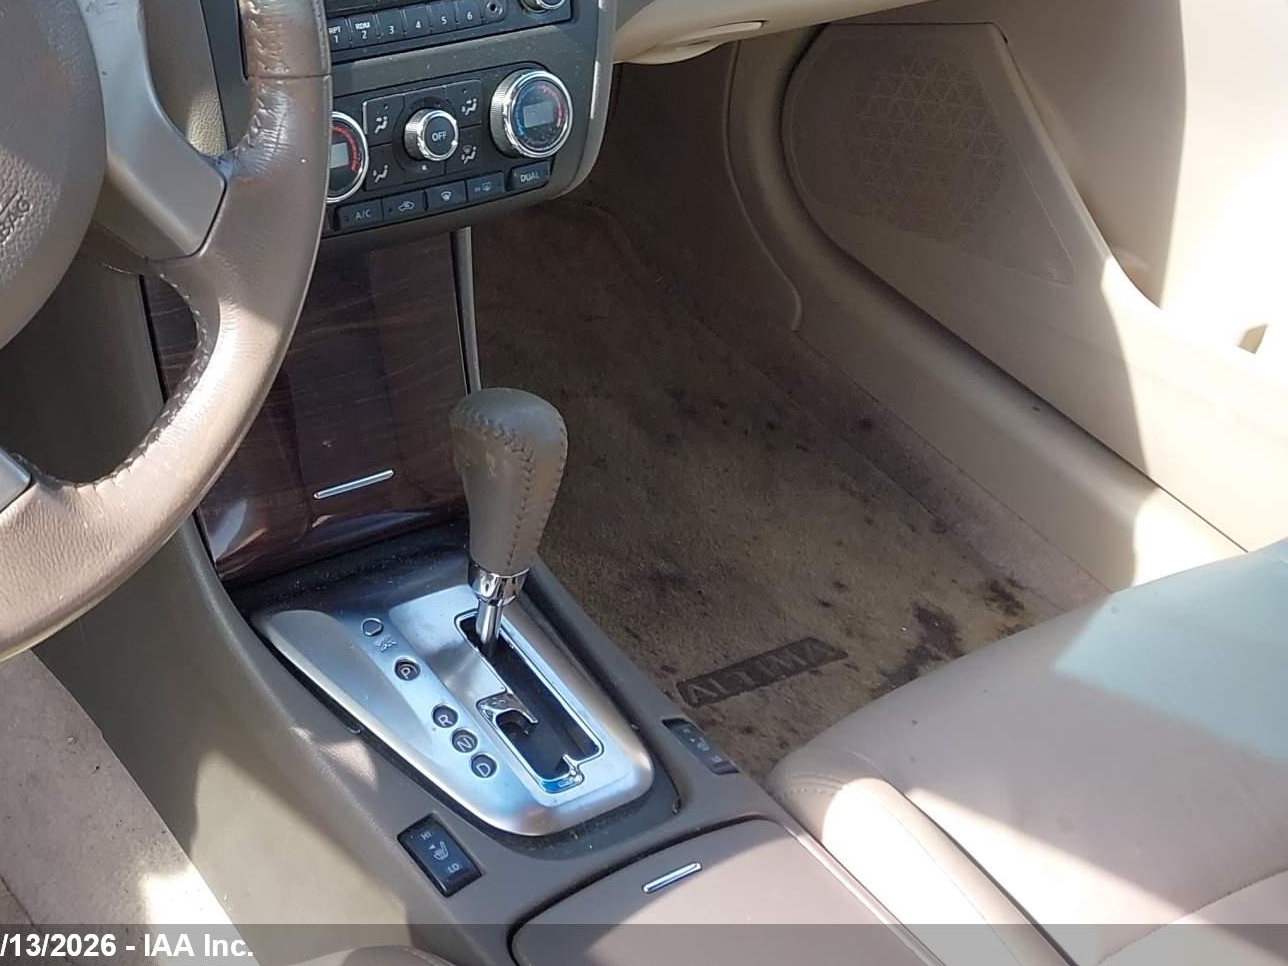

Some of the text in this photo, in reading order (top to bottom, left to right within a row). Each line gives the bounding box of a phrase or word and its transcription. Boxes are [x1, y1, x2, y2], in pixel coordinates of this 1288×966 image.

[431, 131, 447, 142] OFF
[520, 171, 540, 183] DUAL
[355, 208, 372, 221] A/C
[402, 665, 413, 680] P
[438, 713, 452, 727] R
[456, 736, 473, 751] N
[475, 763, 490, 778] D
